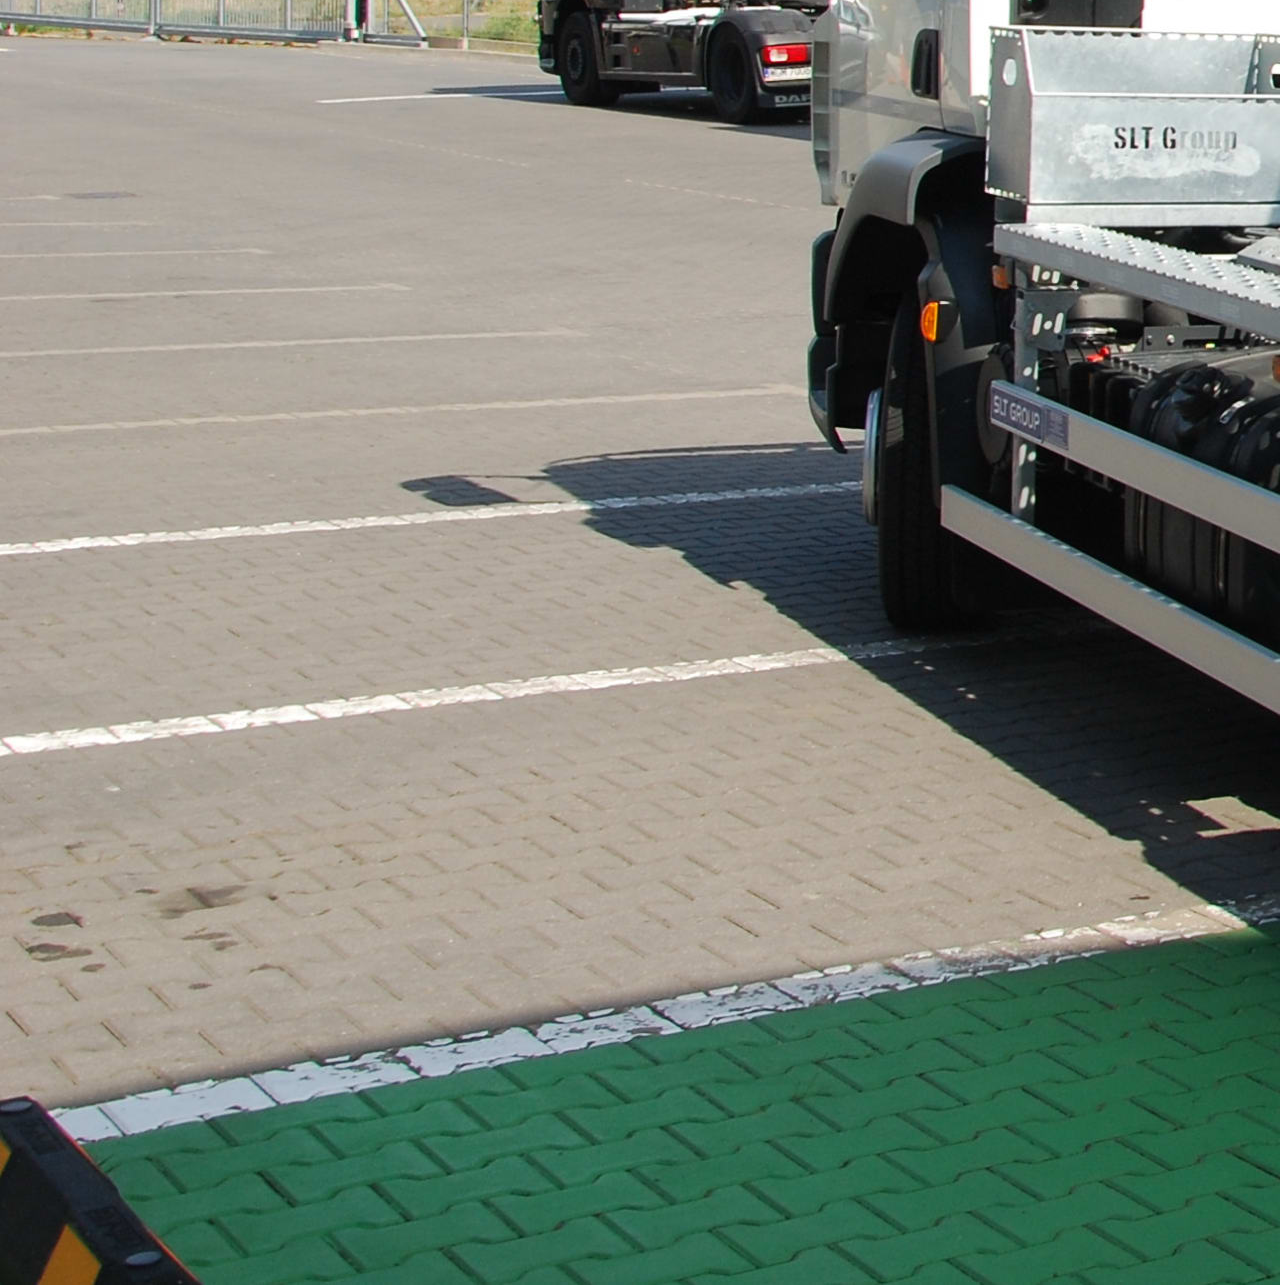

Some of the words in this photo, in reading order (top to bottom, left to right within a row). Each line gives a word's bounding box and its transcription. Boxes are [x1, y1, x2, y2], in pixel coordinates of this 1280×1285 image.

[1114, 126, 1153, 150] SLT
[1162, 126, 1238, 150] Group
[993, 395, 1008, 416] SLT
[1009, 402, 1040, 430] GROUP
